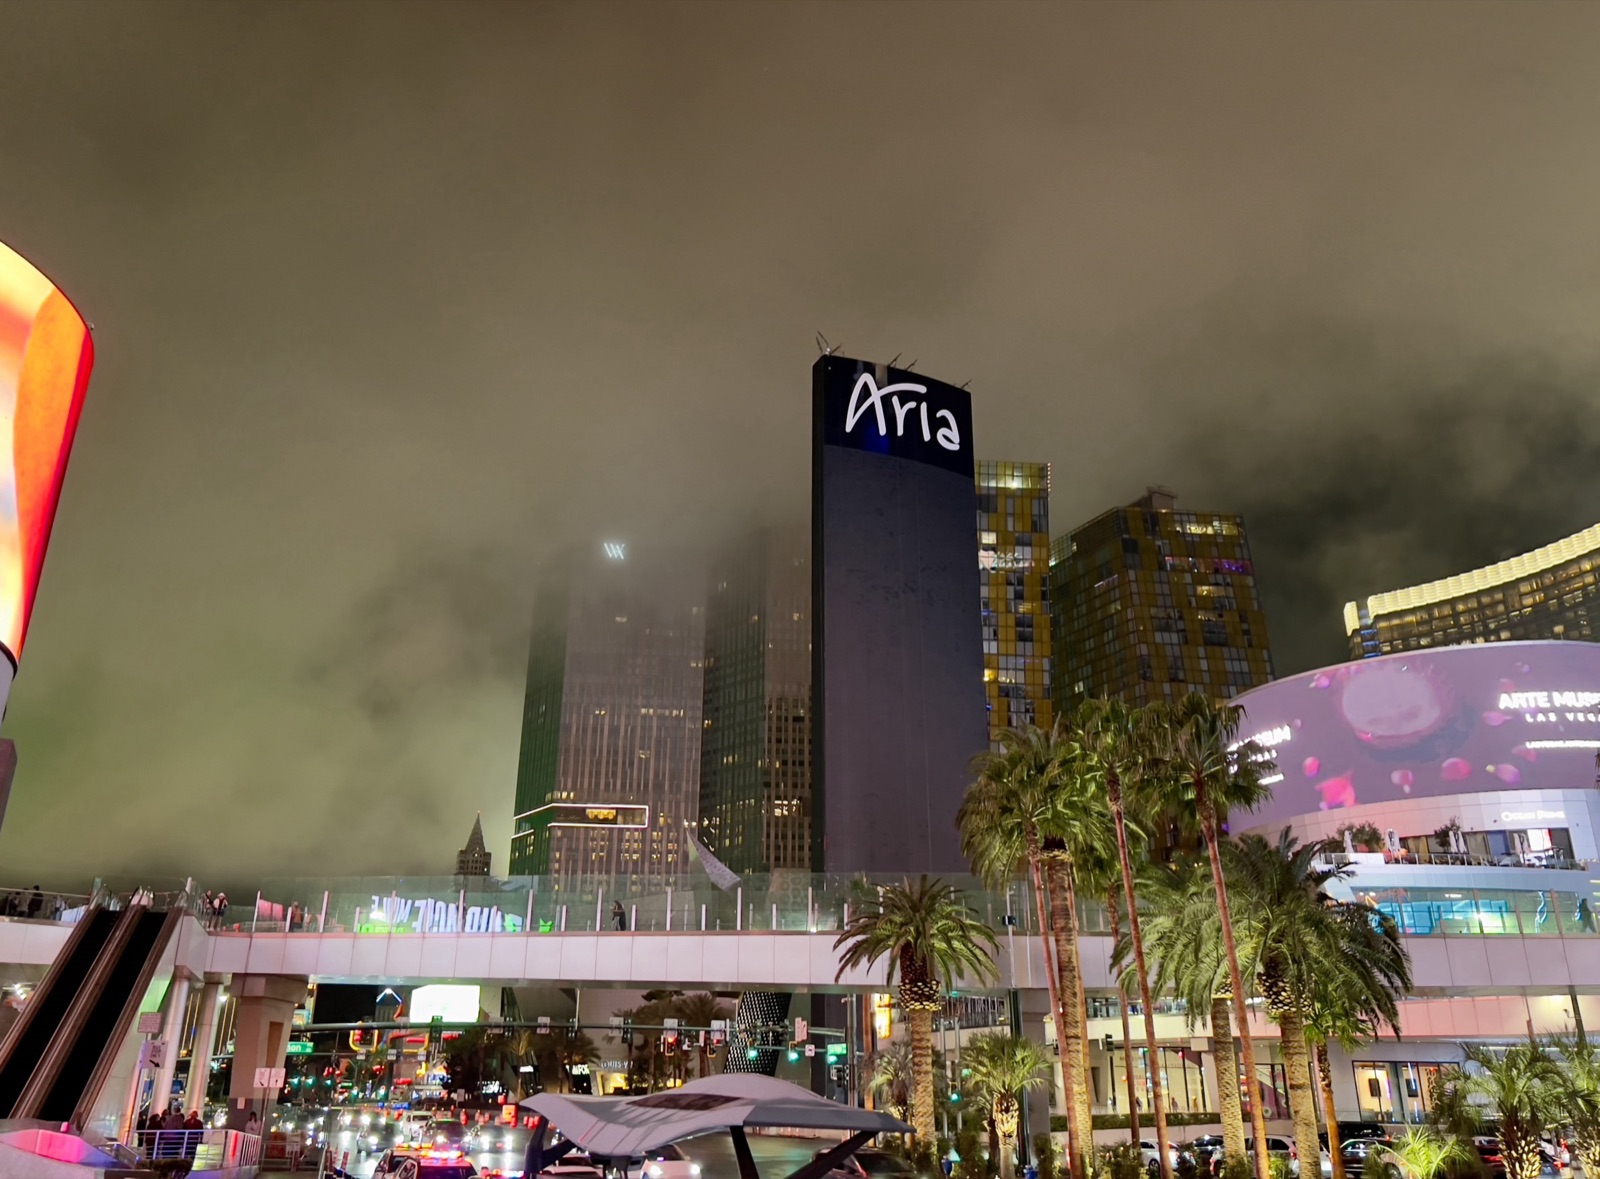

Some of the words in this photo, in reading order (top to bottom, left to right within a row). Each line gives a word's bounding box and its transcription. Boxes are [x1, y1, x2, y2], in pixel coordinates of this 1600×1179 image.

[845, 372, 960, 451] Aria
[1499, 691, 1551, 709] ARTE
[1525, 712, 1557, 722] LAS
[1565, 712, 1600, 722] VEG
